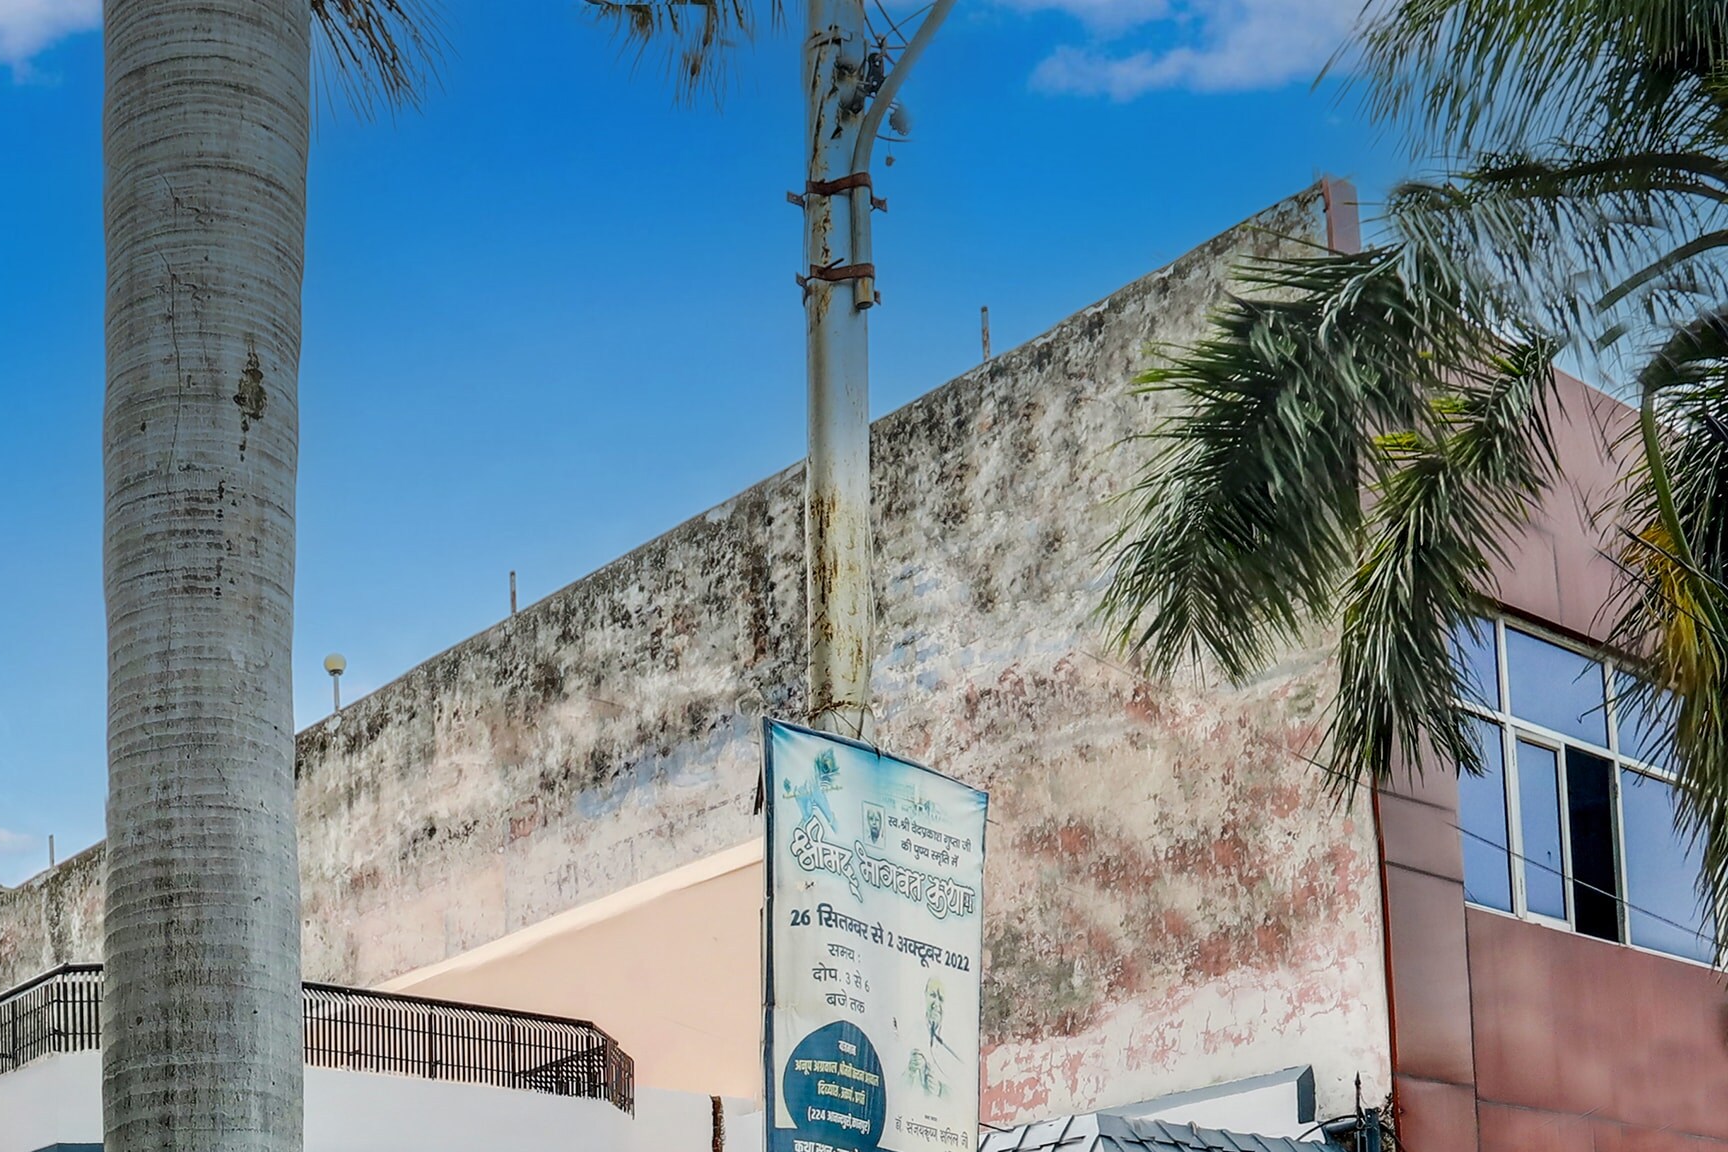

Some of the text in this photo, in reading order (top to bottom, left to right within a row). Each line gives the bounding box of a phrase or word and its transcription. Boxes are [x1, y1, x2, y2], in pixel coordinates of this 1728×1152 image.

[790, 909, 810, 926] 26
[816, 903, 868, 940] सितम्बर
[871, 922, 884, 944] से
[887, 932, 894, 948] 2
[944, 951, 970, 972] 2022
[845, 972, 851, 985] 3
[853, 970, 862, 990] से
[864, 980, 870, 993] 6
[825, 988, 865, 1014] बजे तक
